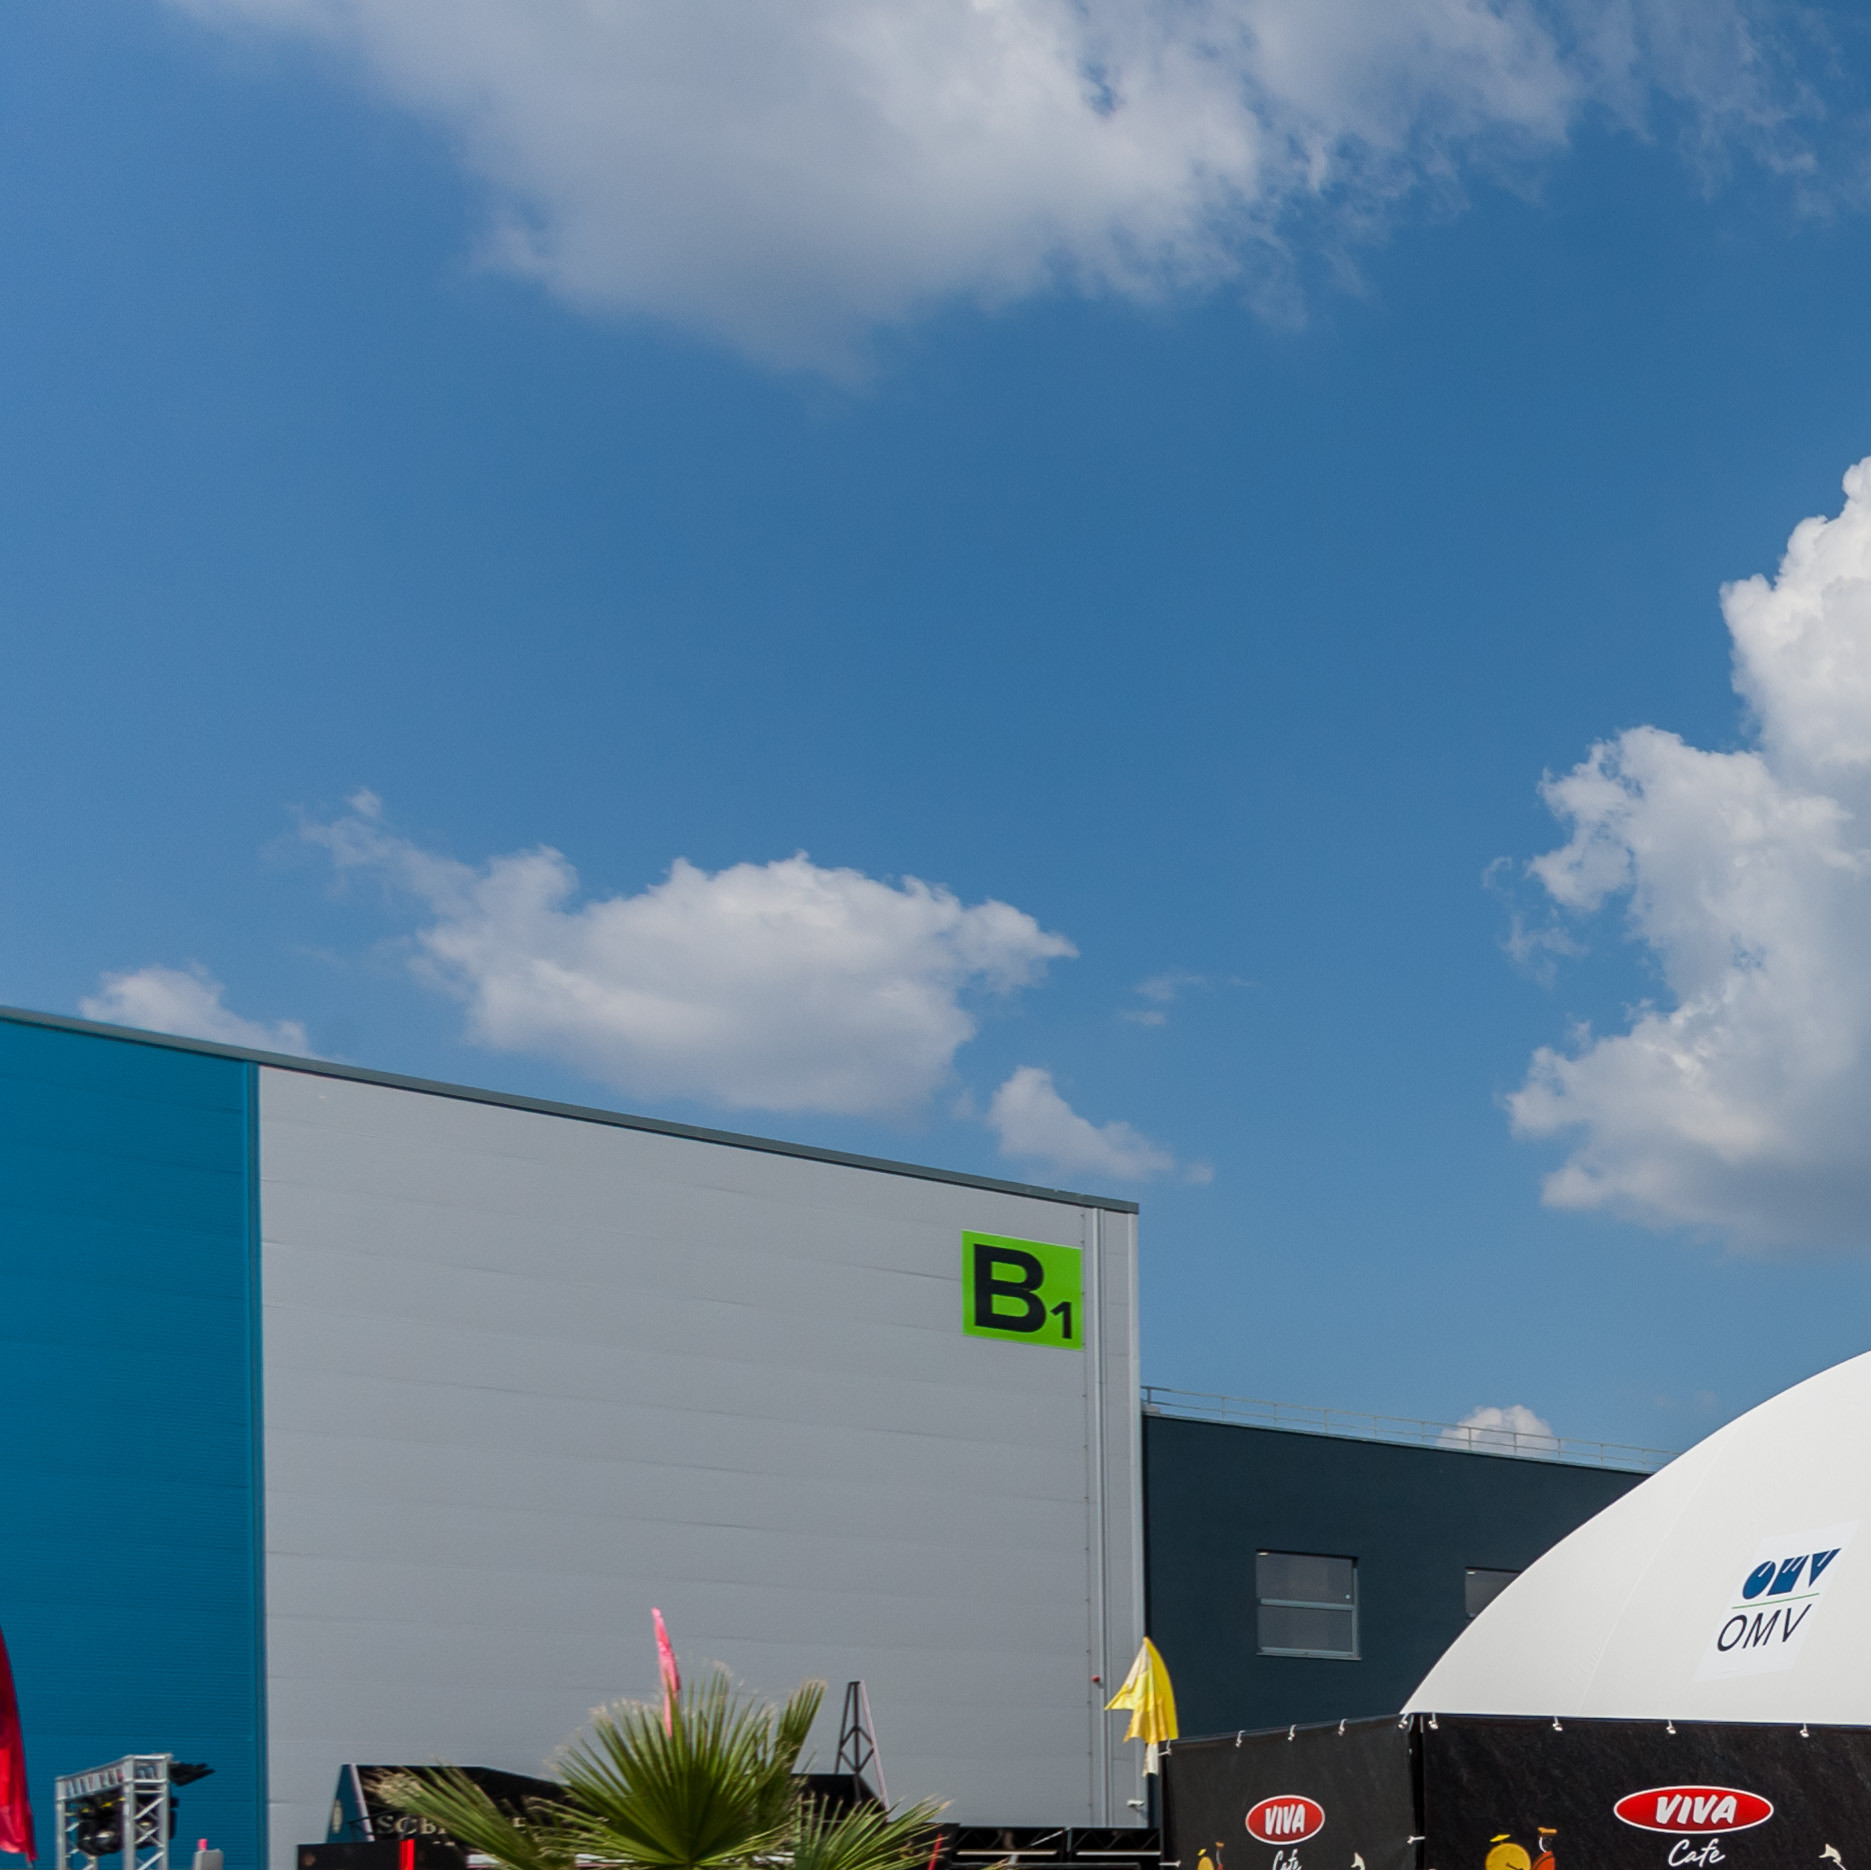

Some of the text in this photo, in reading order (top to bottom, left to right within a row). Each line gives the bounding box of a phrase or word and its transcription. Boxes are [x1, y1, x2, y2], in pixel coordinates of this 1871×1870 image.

[973, 1243, 1074, 1340] B1
[1717, 1604, 1813, 1652] OMV
[1264, 1804, 1306, 1836] VIVA
[1656, 1794, 1738, 1825] VIVA
